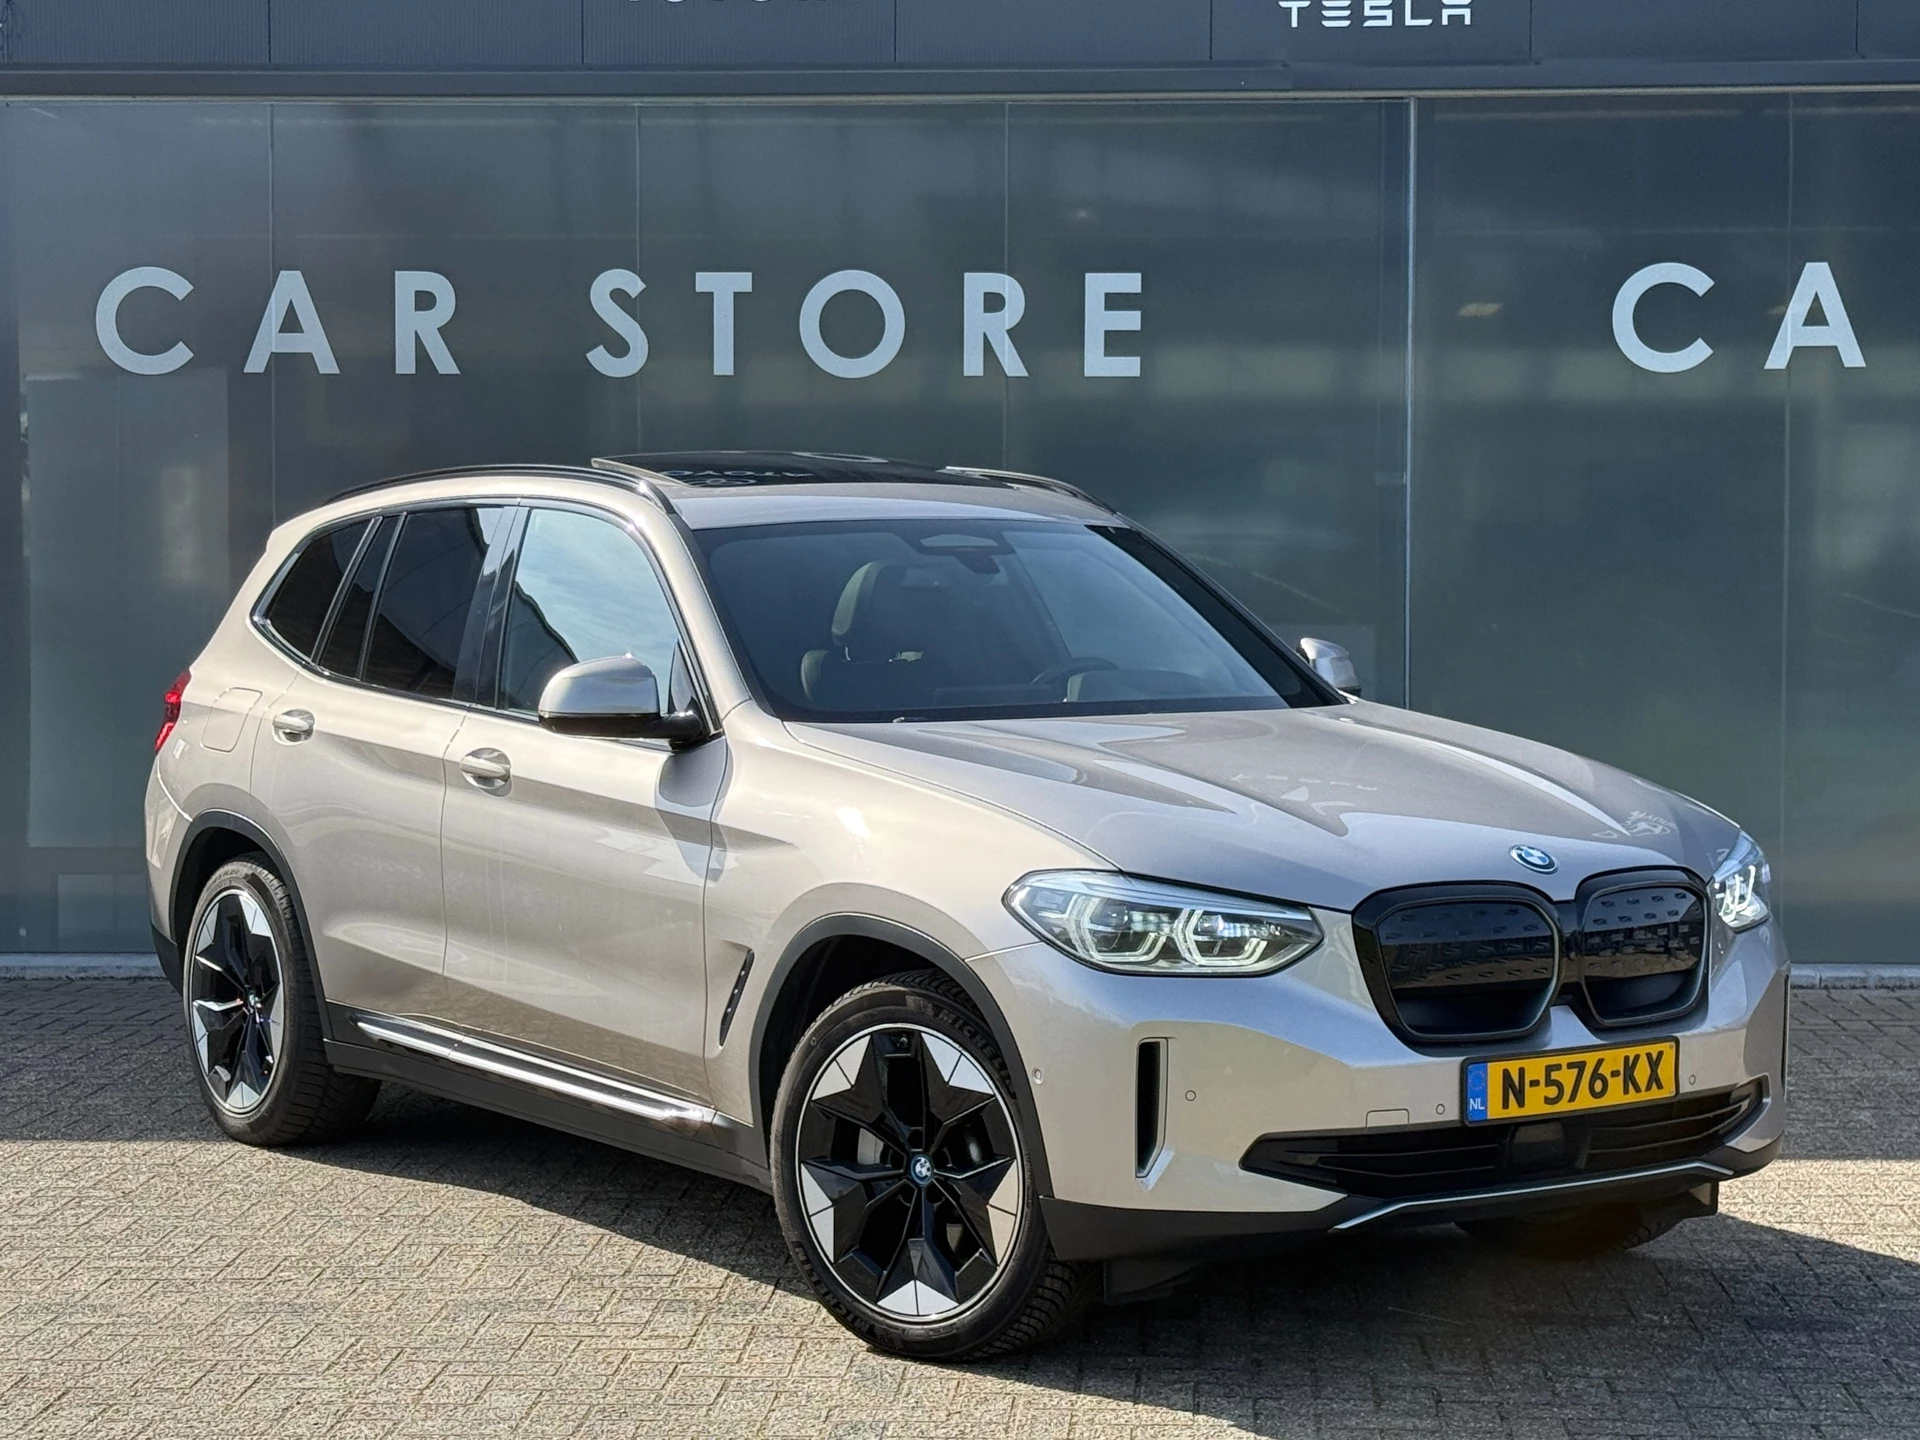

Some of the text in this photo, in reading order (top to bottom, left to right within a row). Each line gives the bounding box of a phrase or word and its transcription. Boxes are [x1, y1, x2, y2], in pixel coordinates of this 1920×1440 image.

[1279, 0, 1471, 28] TESLA
[95, 266, 1142, 378] CAR STORE
[1612, 262, 1866, 373] CA
[1469, 1098, 1486, 1111] NL
[1501, 1050, 1664, 1110] N-576-KX
